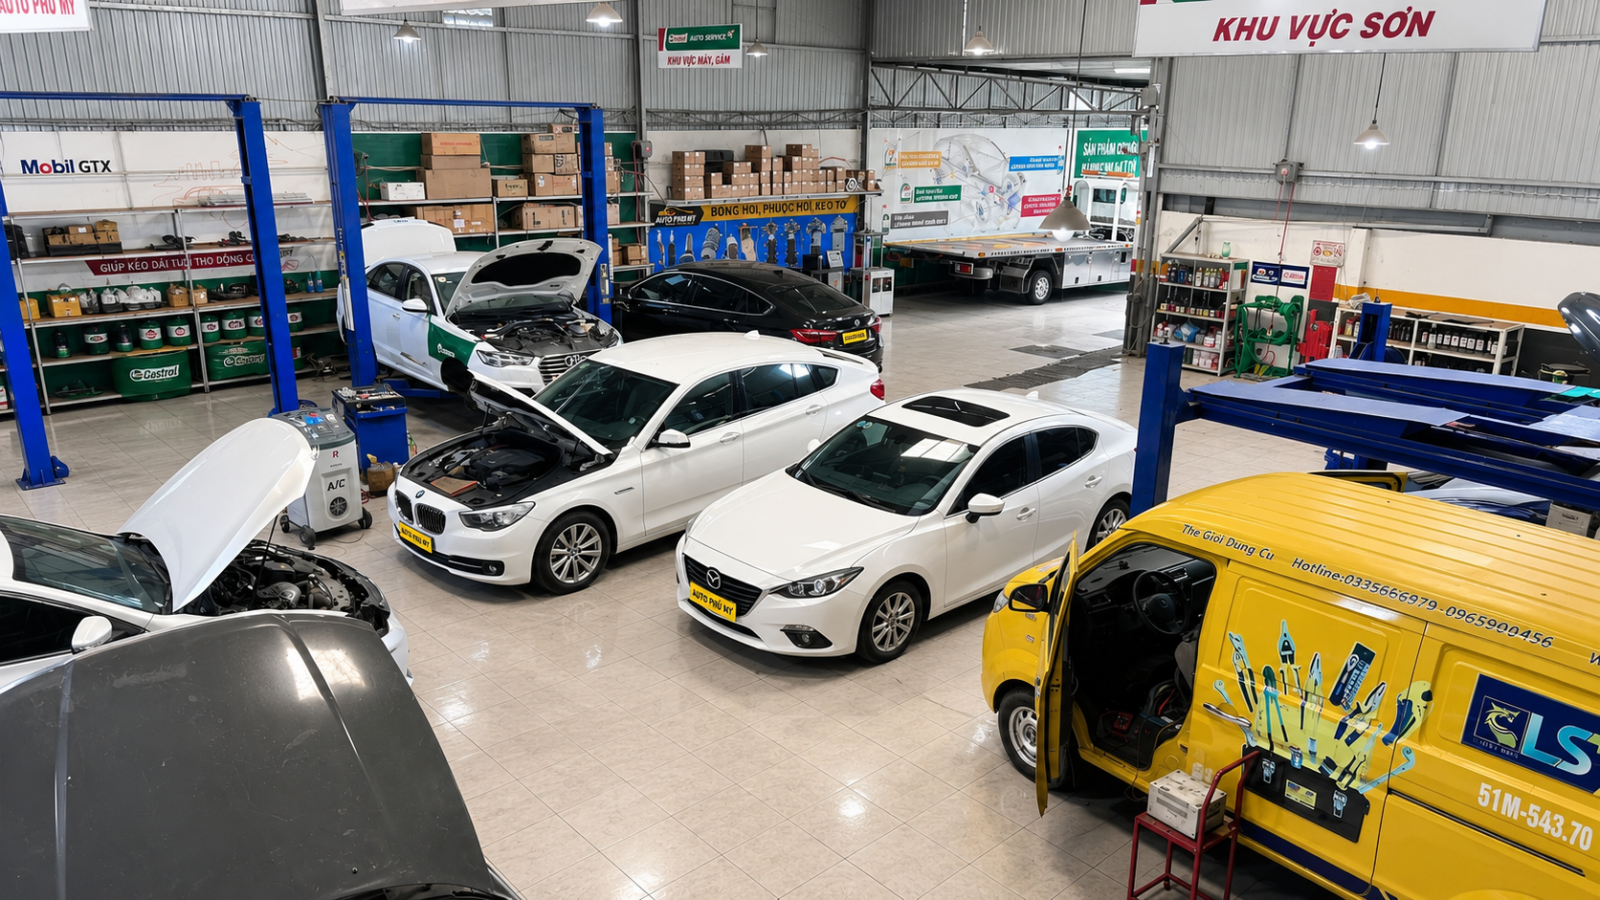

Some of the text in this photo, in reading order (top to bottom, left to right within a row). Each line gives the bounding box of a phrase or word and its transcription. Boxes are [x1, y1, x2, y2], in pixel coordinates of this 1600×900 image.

[1212, 6, 1436, 47] KHU VỰC SƠN
[667, 55, 680, 65] KHU
[20, 159, 112, 174] Mobil GTX
[327, 479, 346, 492] A/C
[1182, 523, 1201, 538] The
[1258, 547, 1275, 561] Cu
[692, 588, 708, 603] AUTO
[1477, 782, 1593, 851] 51M-543.70
